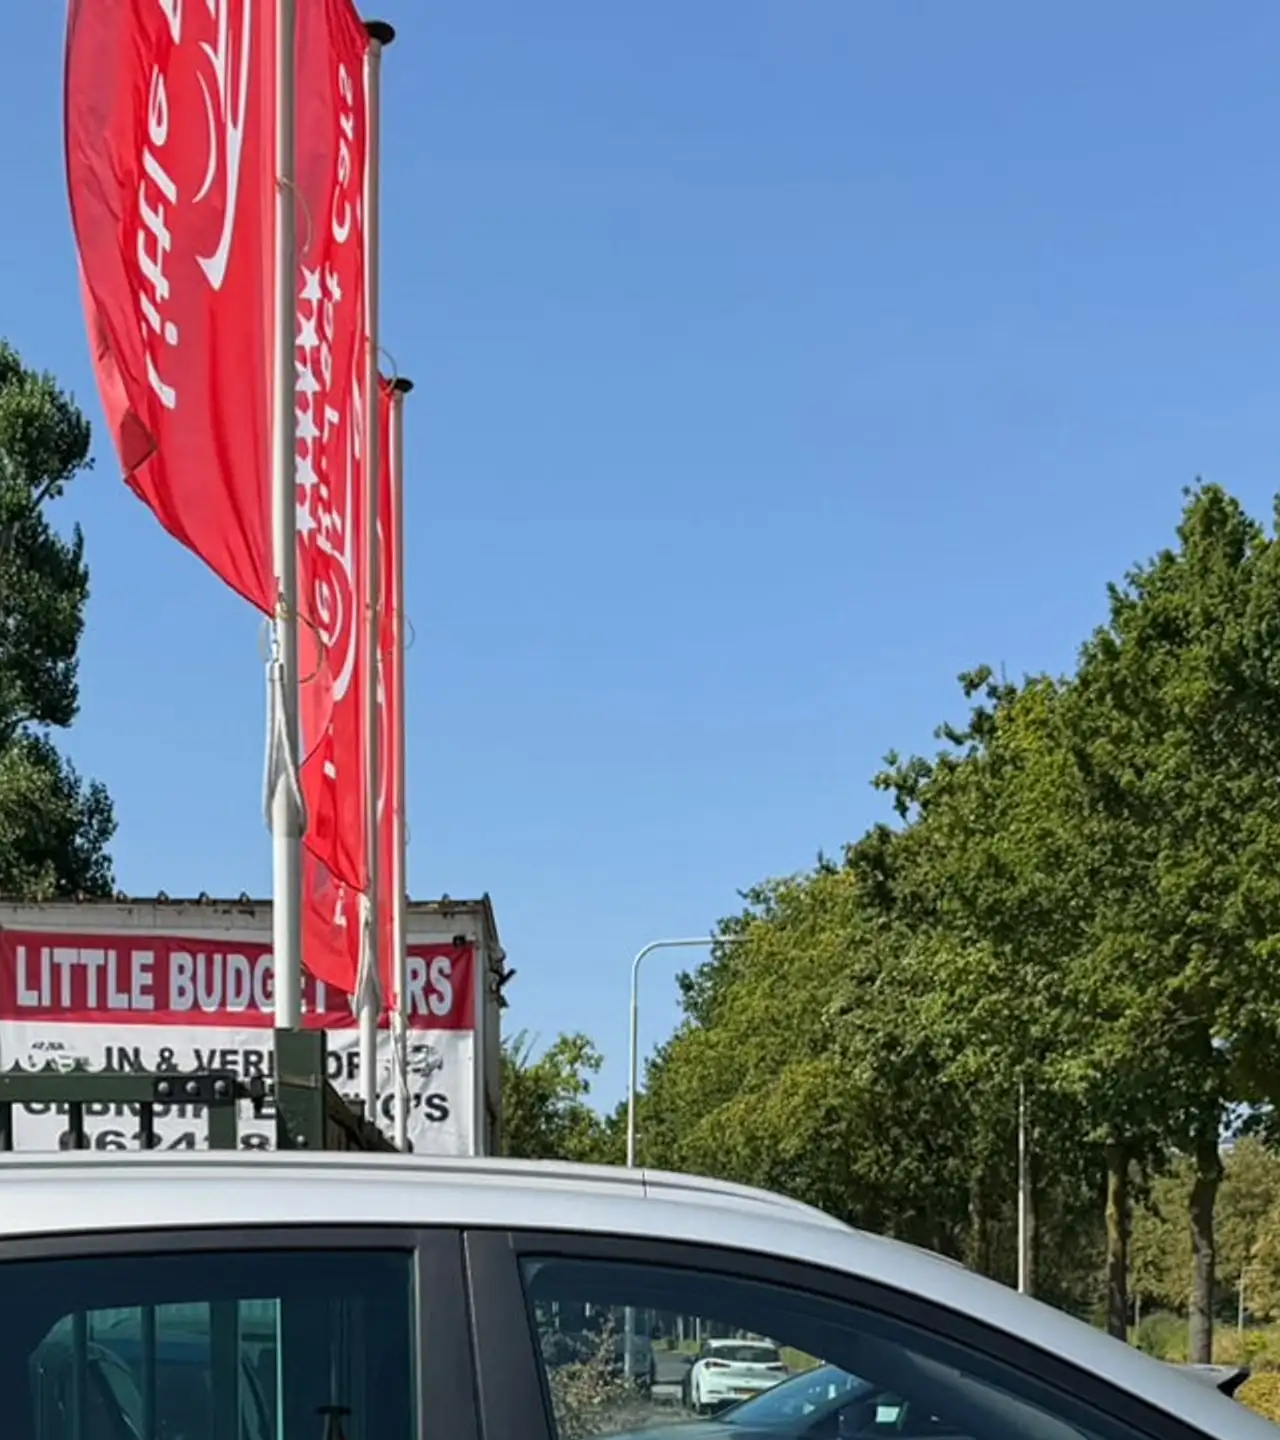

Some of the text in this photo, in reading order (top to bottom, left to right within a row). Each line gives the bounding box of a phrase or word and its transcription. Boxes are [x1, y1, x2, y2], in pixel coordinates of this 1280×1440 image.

[16, 946, 155, 1010] LITTLE
[105, 1046, 140, 1073] IN
[156, 1048, 179, 1072] &
